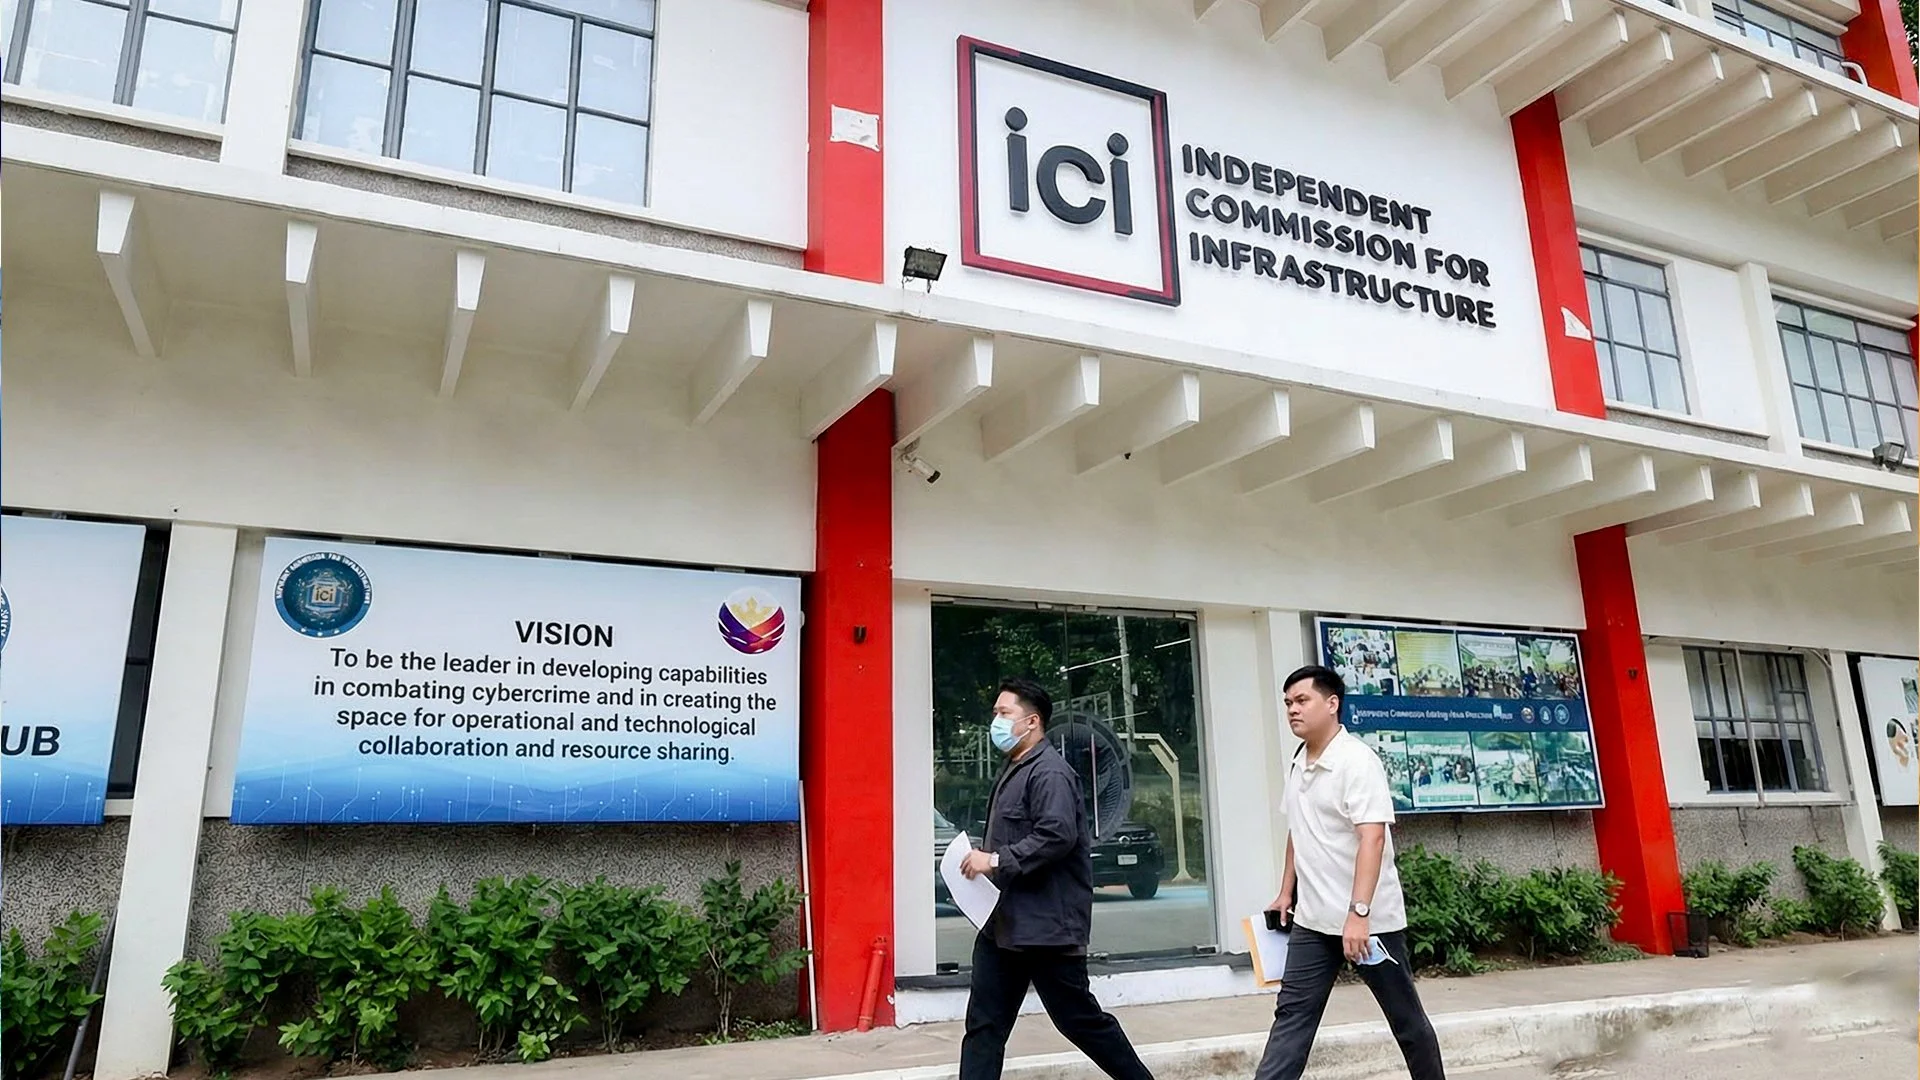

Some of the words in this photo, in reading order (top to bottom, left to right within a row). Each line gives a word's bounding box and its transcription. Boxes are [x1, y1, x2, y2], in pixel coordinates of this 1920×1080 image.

[1004, 106, 1133, 236] ici
[1181, 143, 1432, 235] INDEPENDENT
[1185, 188, 1417, 270] COMMISSION
[1424, 247, 1491, 287] FOR
[1189, 231, 1497, 329] INFRASTRUCTURE
[315, 587, 334, 602] ici
[515, 620, 613, 647] VISION
[330, 647, 358, 668] To
[366, 648, 393, 669] be
[399, 651, 437, 671] the
[443, 652, 511, 675] leader
[517, 656, 535, 676] in
[542, 657, 653, 684] developing
[658, 665, 768, 687] capabilities
[314, 675, 335, 697] in
[342, 678, 466, 706] combating
[472, 682, 591, 706] cybercrime
[596, 687, 634, 706] and
[640, 688, 658, 707] in
[663, 692, 742, 714] creating
[747, 692, 777, 711] the
[336, 708, 408, 731] space
[413, 707, 446, 728] for
[452, 710, 574, 733] operational
[581, 713, 619, 732] and
[624, 714, 756, 739] technological
[358, 734, 508, 758] collaboration
[515, 738, 555, 759] and
[561, 743, 652, 761] resource
[656, 741, 735, 766] sharing.
